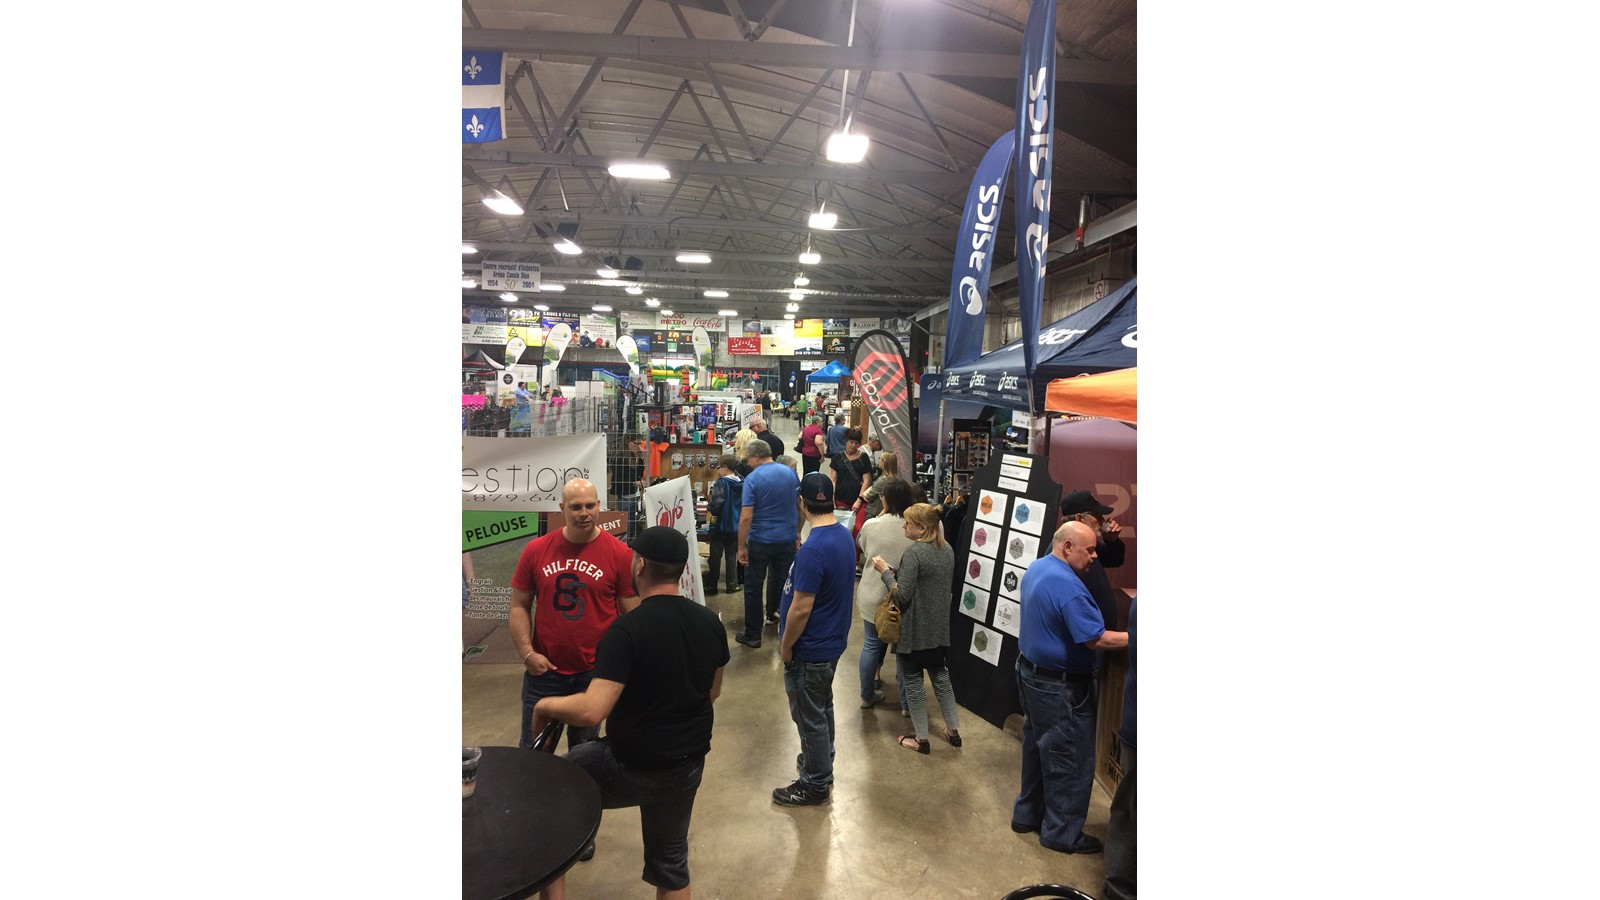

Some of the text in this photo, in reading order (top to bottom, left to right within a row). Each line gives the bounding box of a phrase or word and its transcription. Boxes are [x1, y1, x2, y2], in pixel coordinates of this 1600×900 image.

[969, 184, 999, 272] asics
[483, 262, 497, 270] Centre
[487, 279, 498, 287] 1954
[465, 515, 528, 543] PELOUSE
[543, 558, 604, 581] HILFIGER
